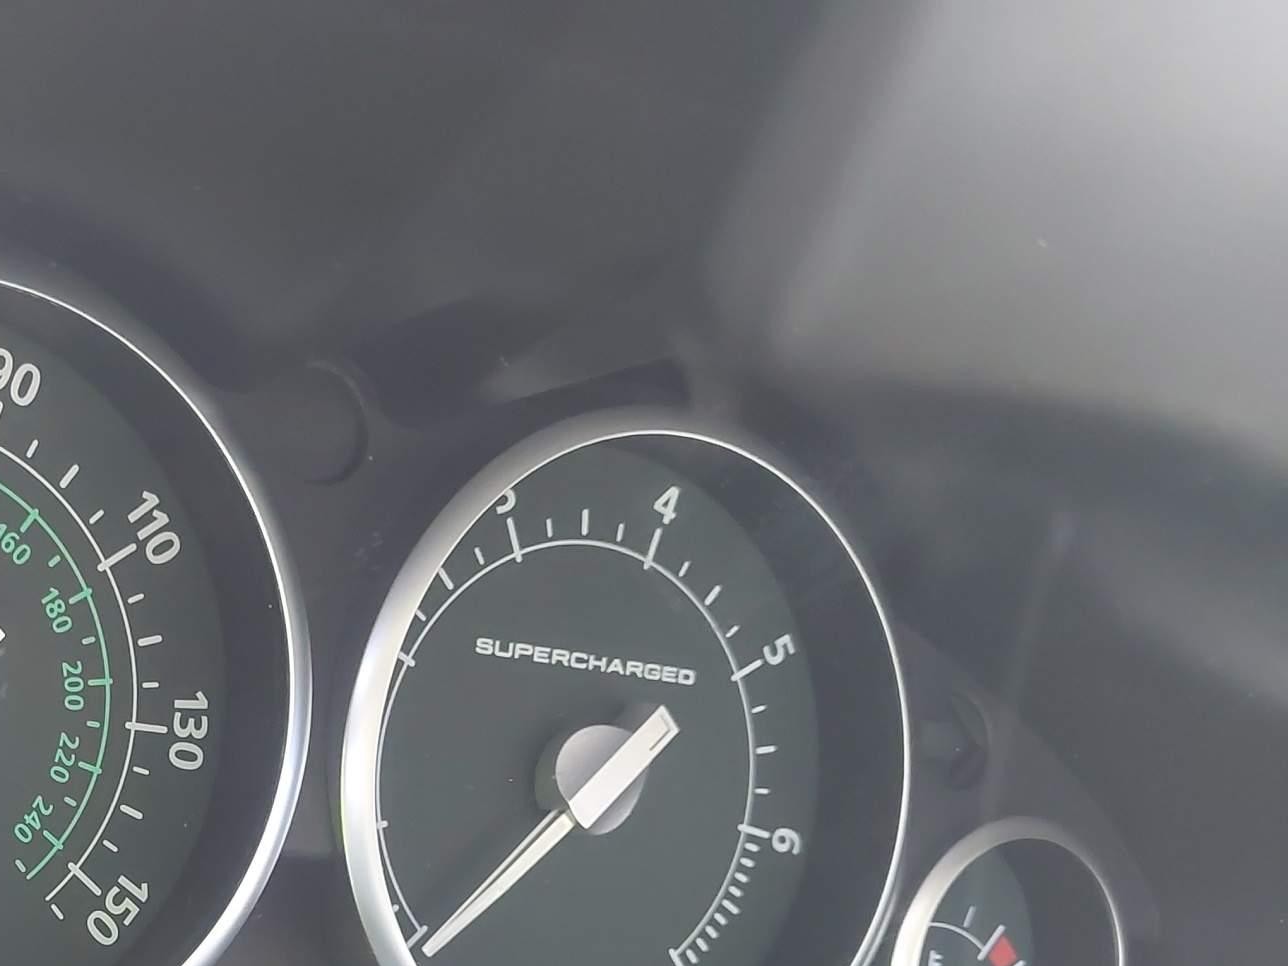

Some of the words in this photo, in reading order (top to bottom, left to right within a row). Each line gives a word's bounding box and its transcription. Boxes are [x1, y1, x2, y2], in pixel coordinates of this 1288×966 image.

[127, 490, 181, 565] 110
[653, 485, 682, 524] 4
[41, 587, 72, 634] 180
[475, 637, 696, 686] SUPERCHARGED
[763, 633, 796, 666] 5
[61, 660, 84, 711] 200
[168, 691, 209, 771] 130
[49, 732, 80, 784] 220
[13, 795, 53, 844] 240
[771, 828, 801, 855] 6
[86, 874, 148, 946] 150
